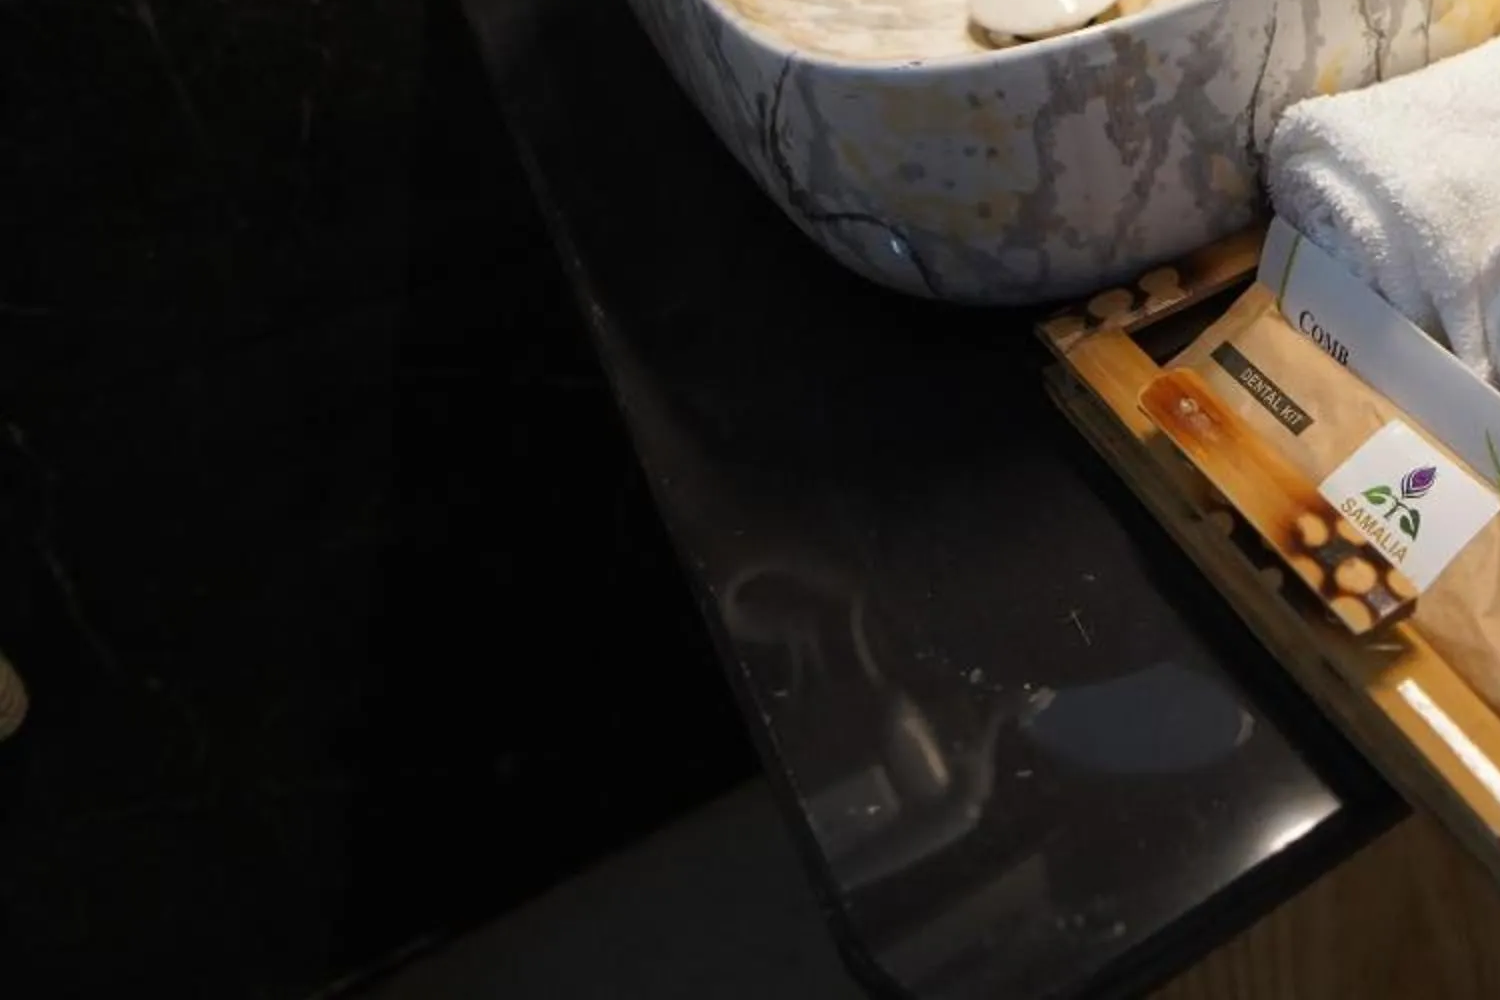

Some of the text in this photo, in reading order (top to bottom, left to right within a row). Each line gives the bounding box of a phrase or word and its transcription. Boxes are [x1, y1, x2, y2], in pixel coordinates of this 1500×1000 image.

[1240, 367, 1304, 426] DENTAL KIT
[1341, 497, 1408, 564] SAMALIA
